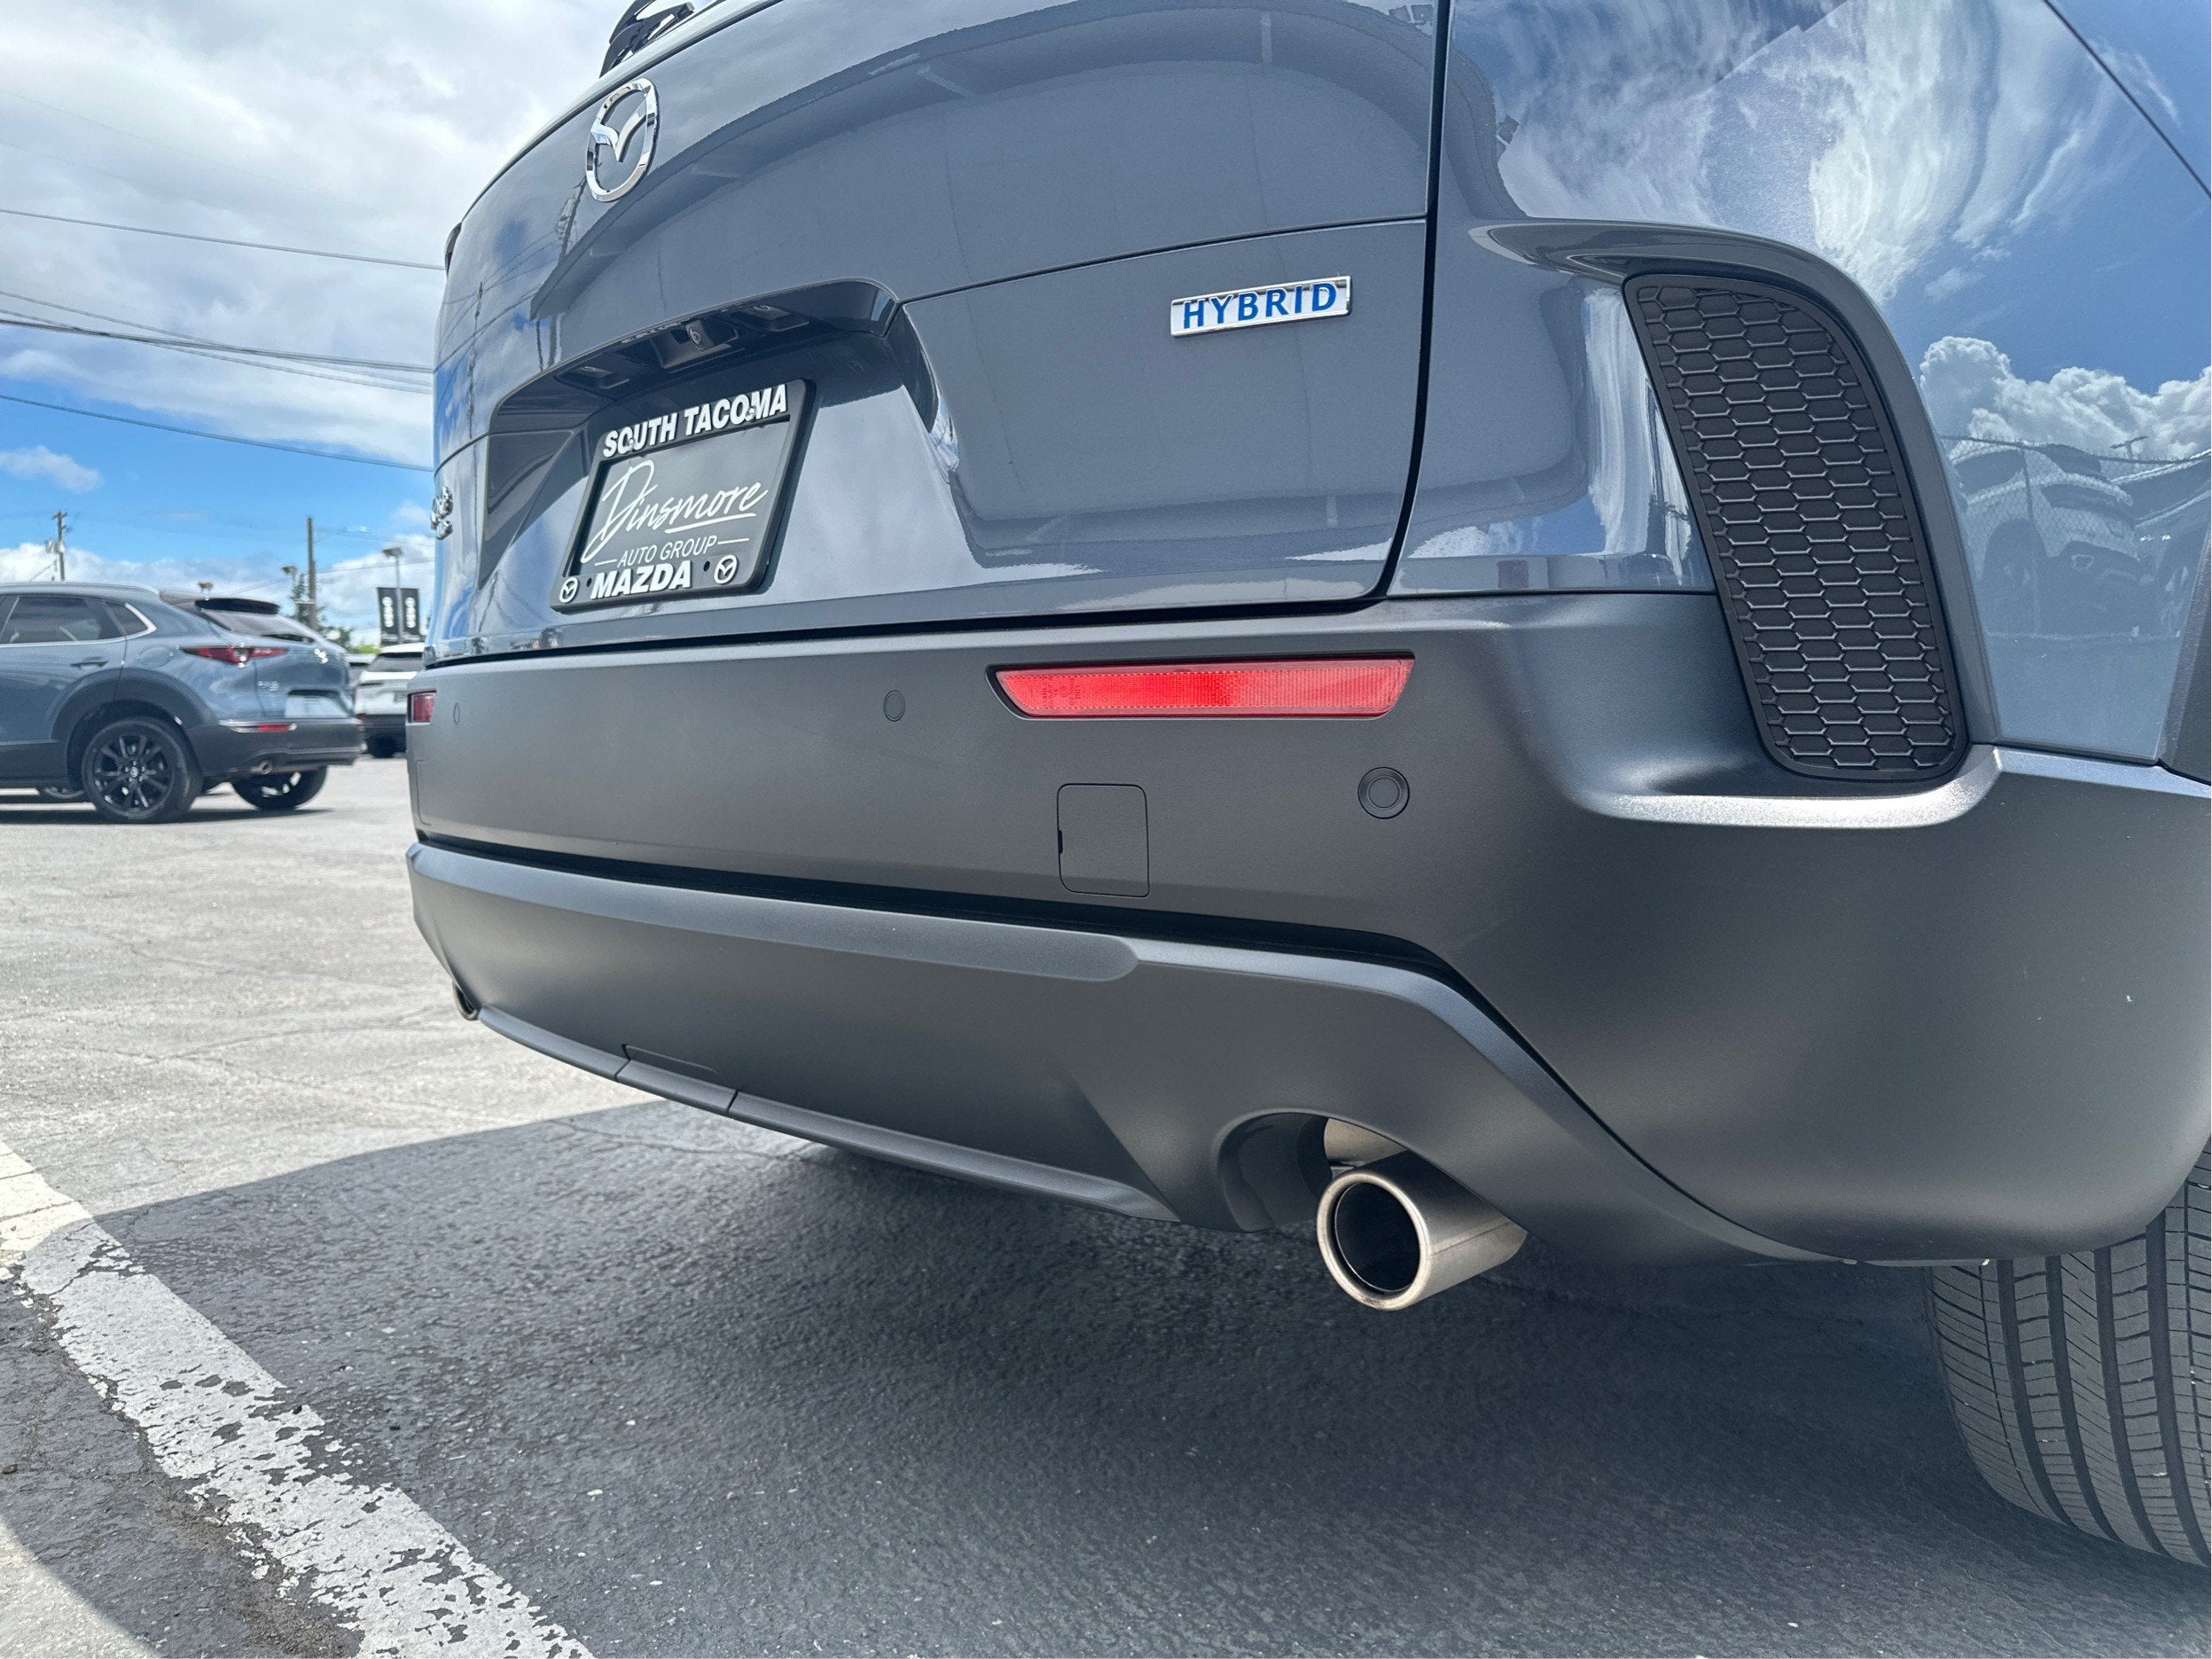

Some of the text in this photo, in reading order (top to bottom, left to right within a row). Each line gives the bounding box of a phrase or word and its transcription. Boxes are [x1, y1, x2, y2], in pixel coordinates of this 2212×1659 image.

[1183, 282, 1338, 330] HYBRID
[603, 383, 788, 458] SOUTH TACOMA
[580, 459, 769, 564] Dinsmore
[617, 535, 718, 567] AUTO GROUP
[590, 560, 692, 600] MAZDA
